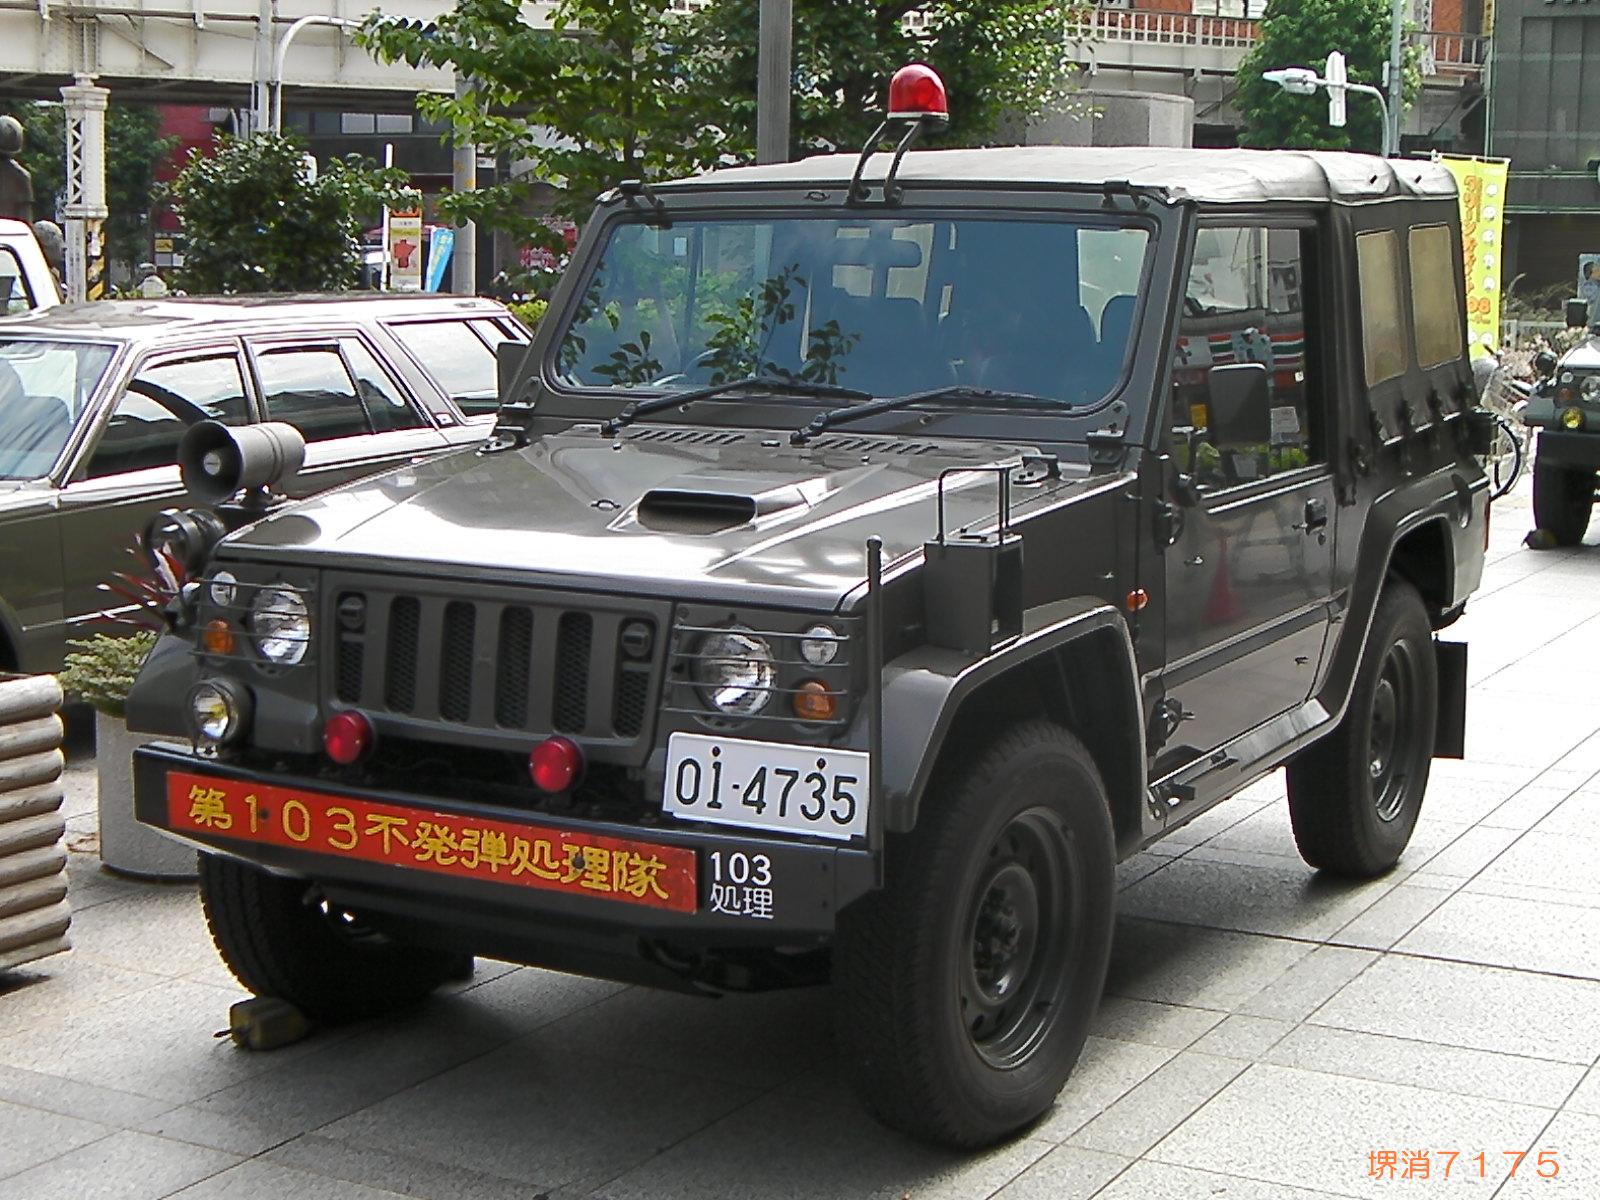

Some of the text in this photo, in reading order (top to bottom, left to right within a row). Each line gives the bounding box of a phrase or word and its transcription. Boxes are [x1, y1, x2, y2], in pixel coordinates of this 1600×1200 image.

[676, 757, 858, 825] 01-4735
[709, 851, 772, 886] 103
[709, 883, 775, 920] 処理
